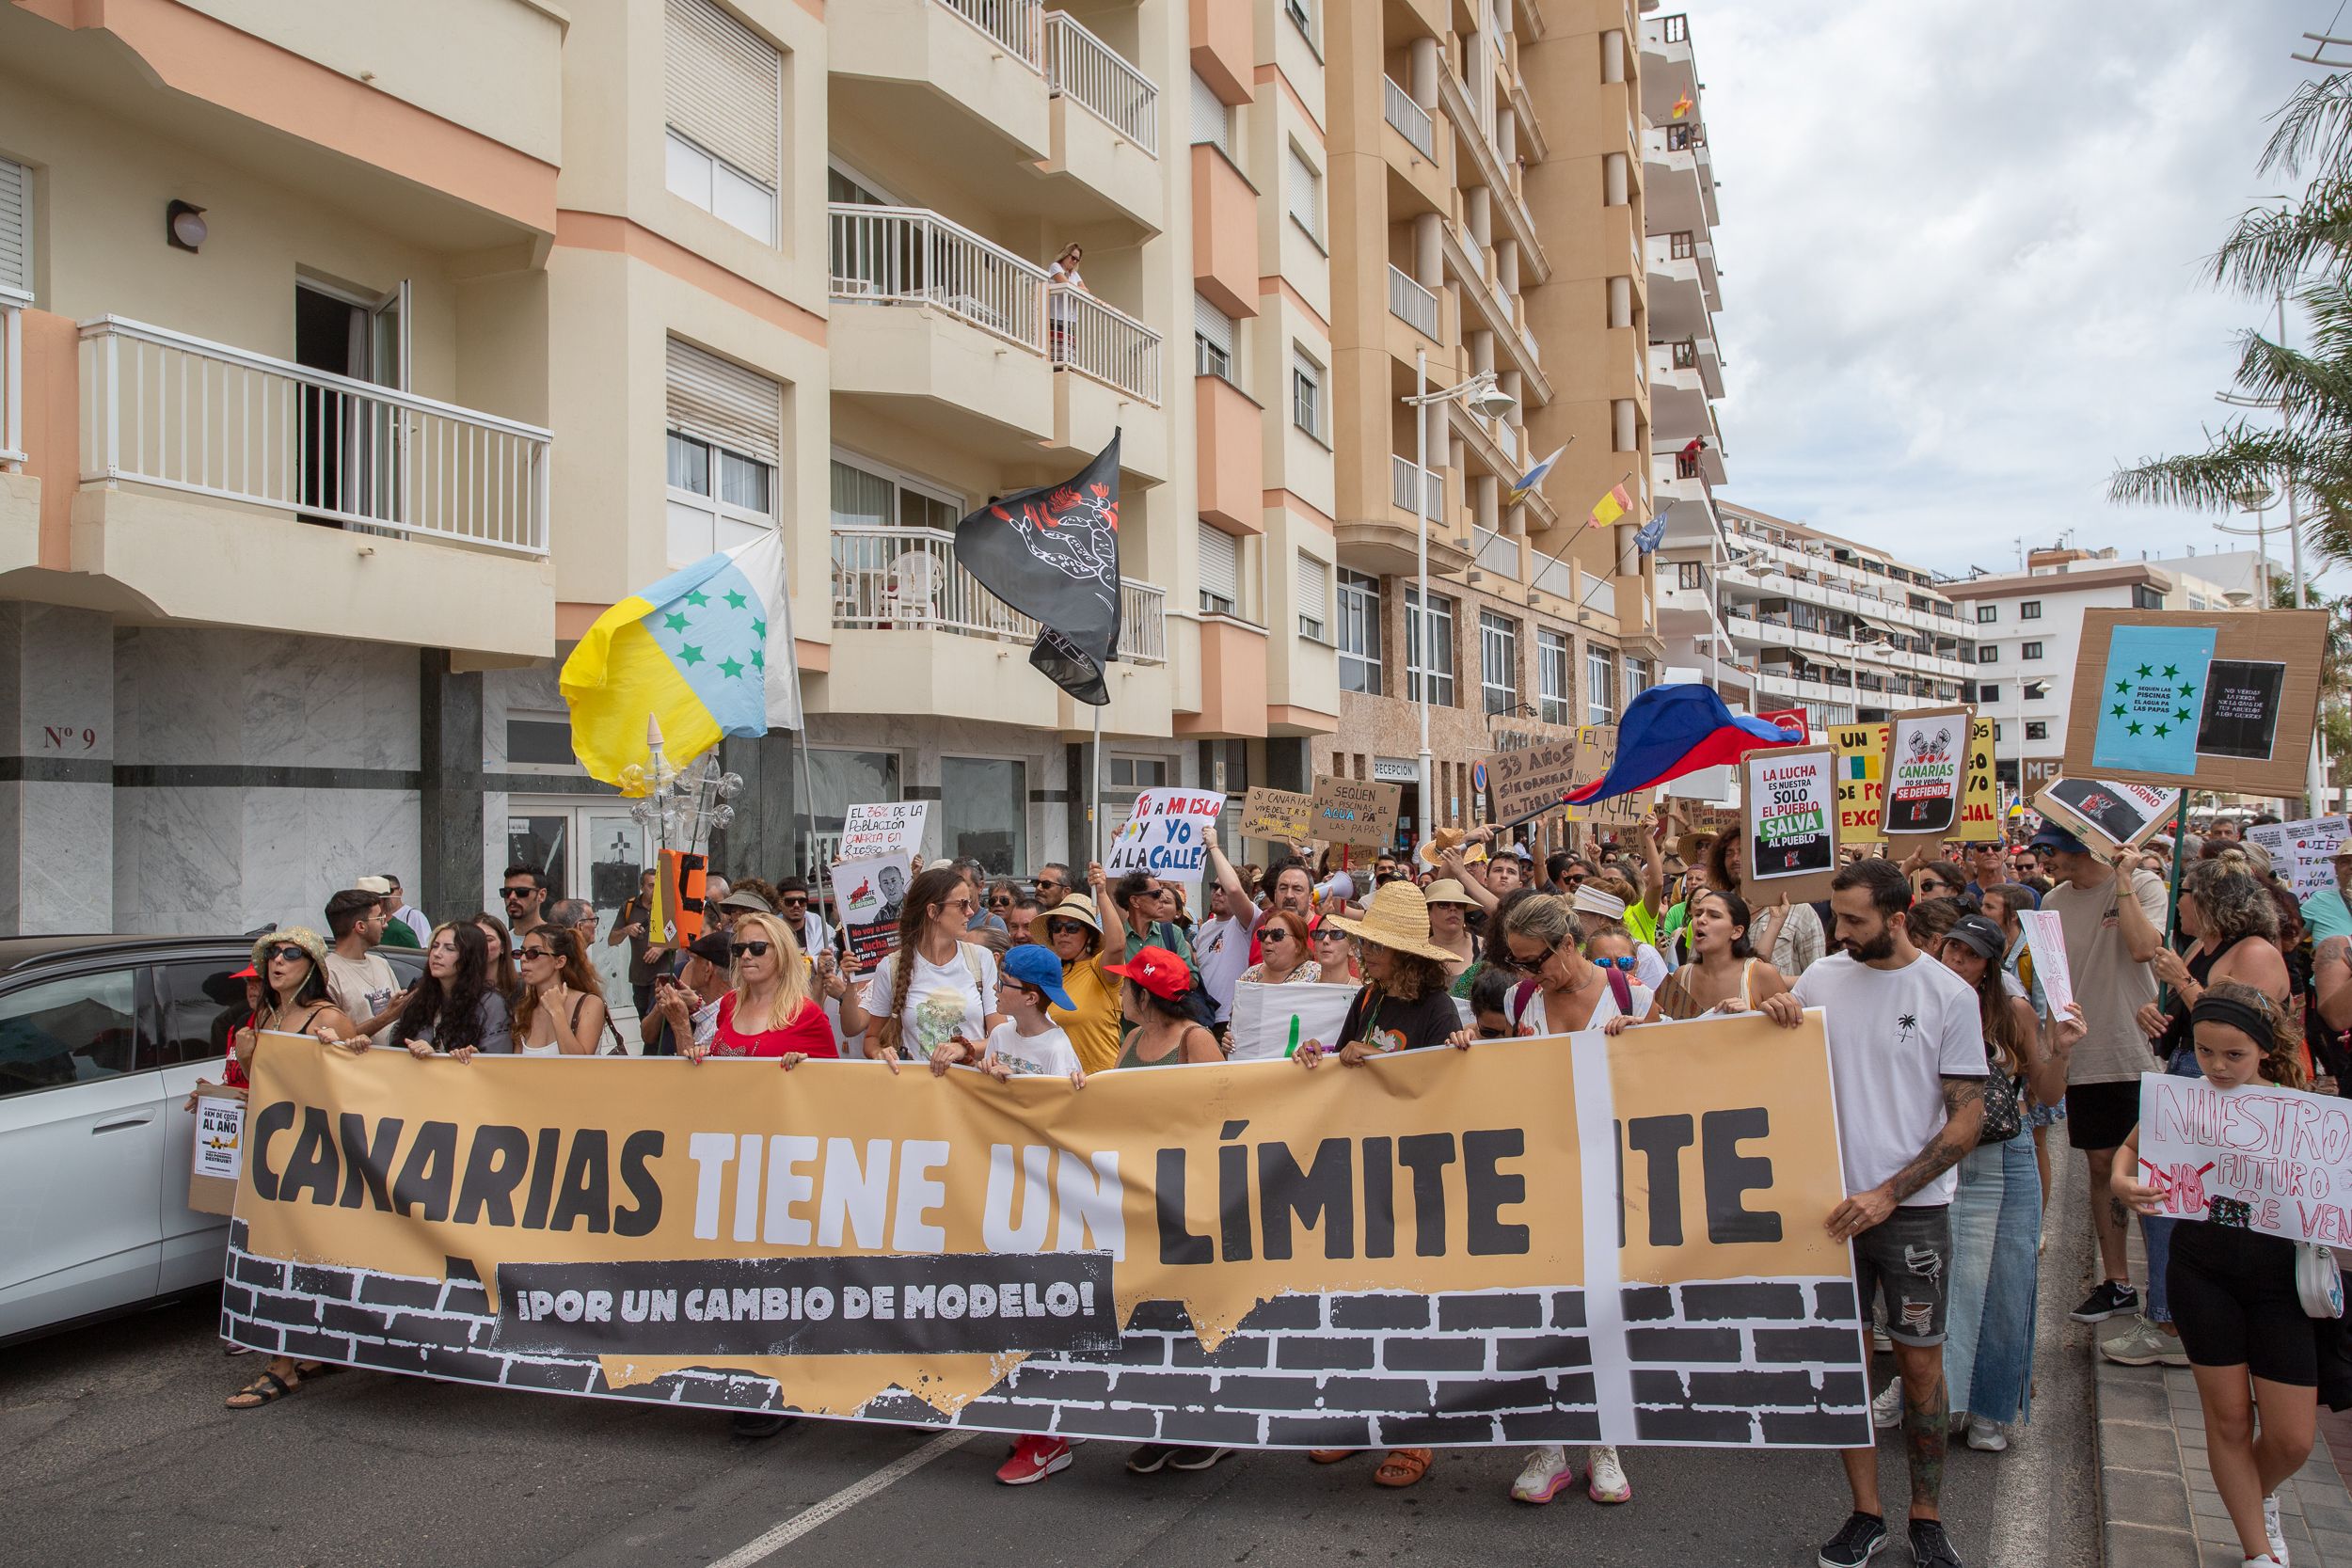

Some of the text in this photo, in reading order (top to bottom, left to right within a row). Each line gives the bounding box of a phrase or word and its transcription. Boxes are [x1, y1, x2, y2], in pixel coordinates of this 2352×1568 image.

[2137, 691, 2171, 700] PISCINAS
[43, 726, 96, 751] Nº 9
[1583, 730, 1598, 749] EL
[1840, 732, 1867, 748] UN
[1375, 763, 1412, 776] RECEPCIÓN
[1498, 755, 1522, 781] 33
[1529, 742, 1575, 771] AÑOS
[1762, 765, 1817, 782] LA LUCHA
[1899, 764, 1954, 779] CANARIAS
[2026, 762, 2064, 781] ME
[1769, 779, 1812, 791] ES NUESTRA
[1924, 777, 1944, 786] vende
[1334, 786, 1376, 802] SEQUEN
[1500, 780, 1522, 800] SIN
[1773, 788, 1808, 804] SOLO
[1898, 784, 1949, 799] SE DEFIENDE
[851, 804, 923, 818] EL 36% DE LA
[1136, 794, 1220, 819] TÚ A MI ISLA
[1271, 806, 1285, 815] DEL
[1320, 797, 1334, 807] LAS
[1377, 806, 1389, 815] EL
[1322, 807, 1355, 821] AGUA
[1502, 802, 1522, 817] EL
[1762, 800, 1819, 818] EL PUEBLO
[1137, 818, 1191, 845] Y YO
[1245, 819, 1258, 829] LAS
[1254, 826, 1269, 834] PARA
[1329, 823, 1382, 837] LAS PAPAS
[1765, 815, 1818, 838] SALVA
[846, 832, 883, 845] CANARIA
[1769, 833, 1816, 848] AL PUEBLO
[1110, 847, 1122, 869] A
[1125, 847, 1147, 868] LA
[851, 927, 862, 938] No
[863, 926, 875, 937] voy
[863, 938, 888, 953] lucha
[202, 1118, 237, 1134] AL AÑO
[2154, 1085, 2350, 1165] NUESTRO
[252, 1101, 664, 1238] CANARIAS
[690, 1132, 950, 1254] TIENE
[982, 1144, 1126, 1262] UN
[1155, 1118, 1531, 1265] LÍMITE
[2217, 1153, 2330, 1200] FUTURO
[517, 1281, 1095, 1323] ¡POR UN CAMBIO DE MODELO!
